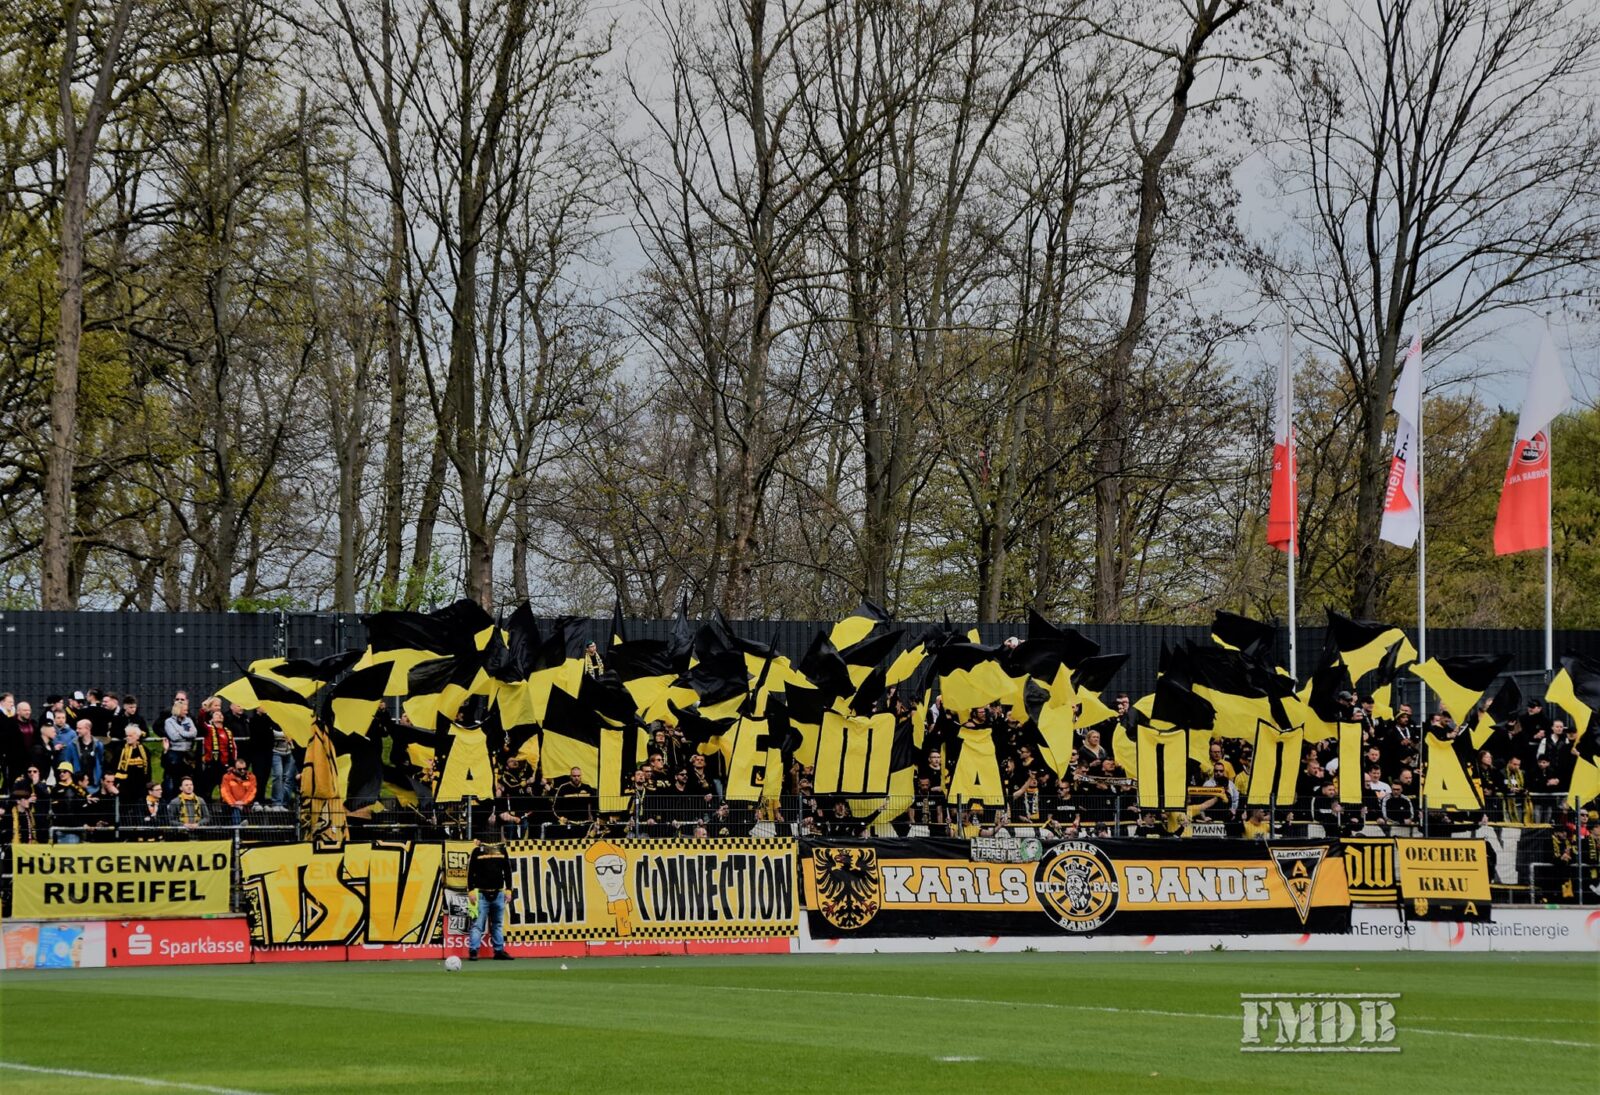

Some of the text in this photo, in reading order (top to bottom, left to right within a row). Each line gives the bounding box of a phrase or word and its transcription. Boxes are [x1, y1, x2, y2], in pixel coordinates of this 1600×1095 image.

[1055, 841, 1098, 856] KARLS
[1277, 850, 1320, 858] ALEMANNIA
[1405, 847, 1477, 862] OECHER
[16, 853, 228, 875] HÜRTGENWALD
[1292, 860, 1308, 877] A
[43, 879, 206, 905] RUREIFEL
[240, 841, 444, 945] TSV
[508, 853, 792, 925] ELLOW CONNECTION
[881, 866, 1030, 904] KARLS
[1125, 866, 1270, 903] BANDE
[1419, 877, 1469, 892] KRAU
[1464, 901, 1478, 916] A
[1059, 917, 1103, 931] BANDE
[1471, 921, 1570, 939] RheinEnergie
[160, 936, 244, 957] Sparkasse
